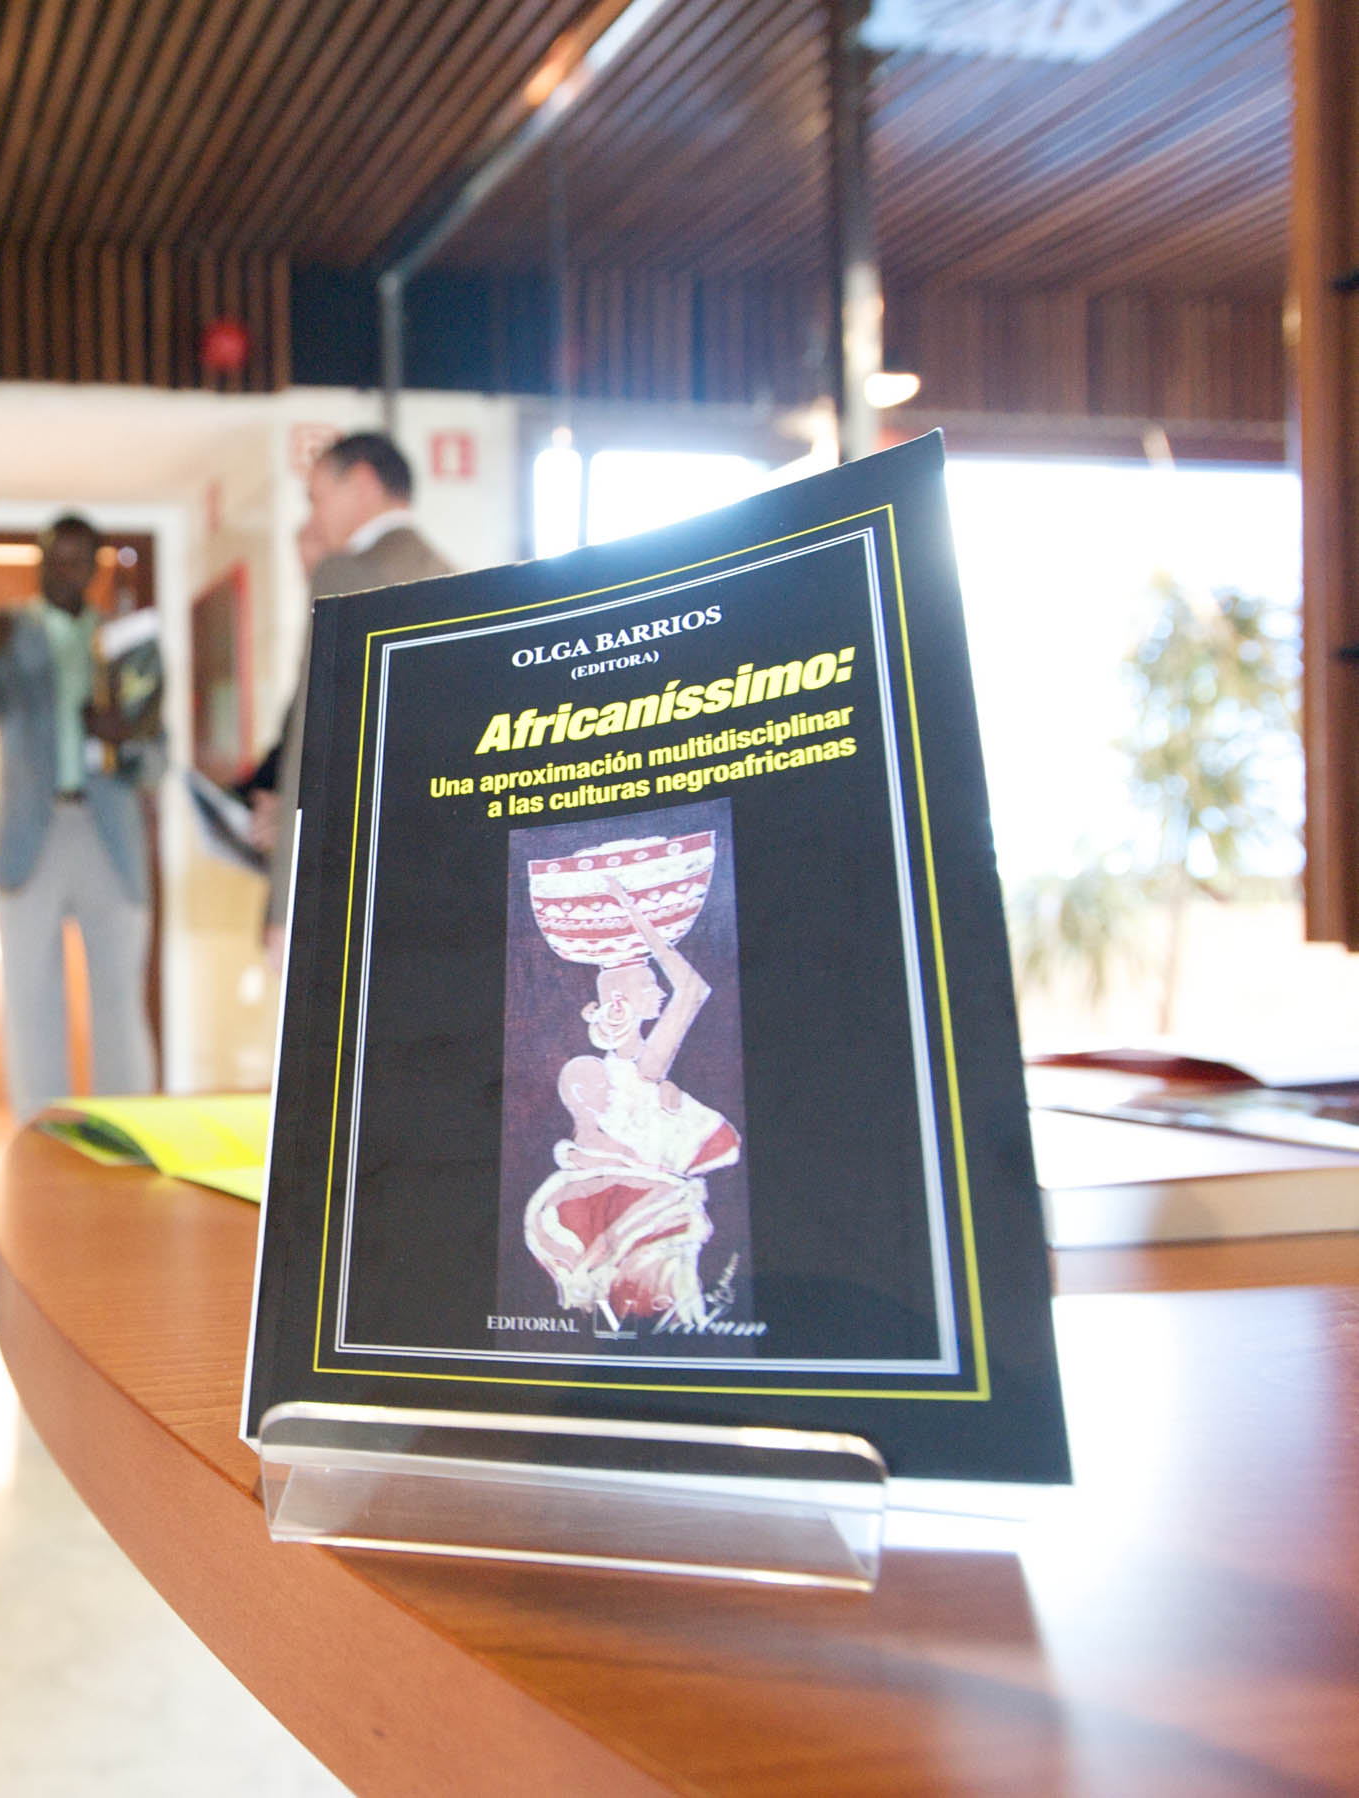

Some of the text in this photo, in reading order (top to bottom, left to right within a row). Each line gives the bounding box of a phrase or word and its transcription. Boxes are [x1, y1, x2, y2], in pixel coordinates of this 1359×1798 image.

[512, 605, 722, 668] OLGA BARRIOS
[571, 650, 660, 680] (EDITORA)
[475, 646, 856, 755] Africaníssimo:
[430, 706, 854, 798] Una aproximación multidisciplinar
[488, 737, 857, 818] a las culturas negroafricanas
[487, 1315, 580, 1334] EDITORIAL
